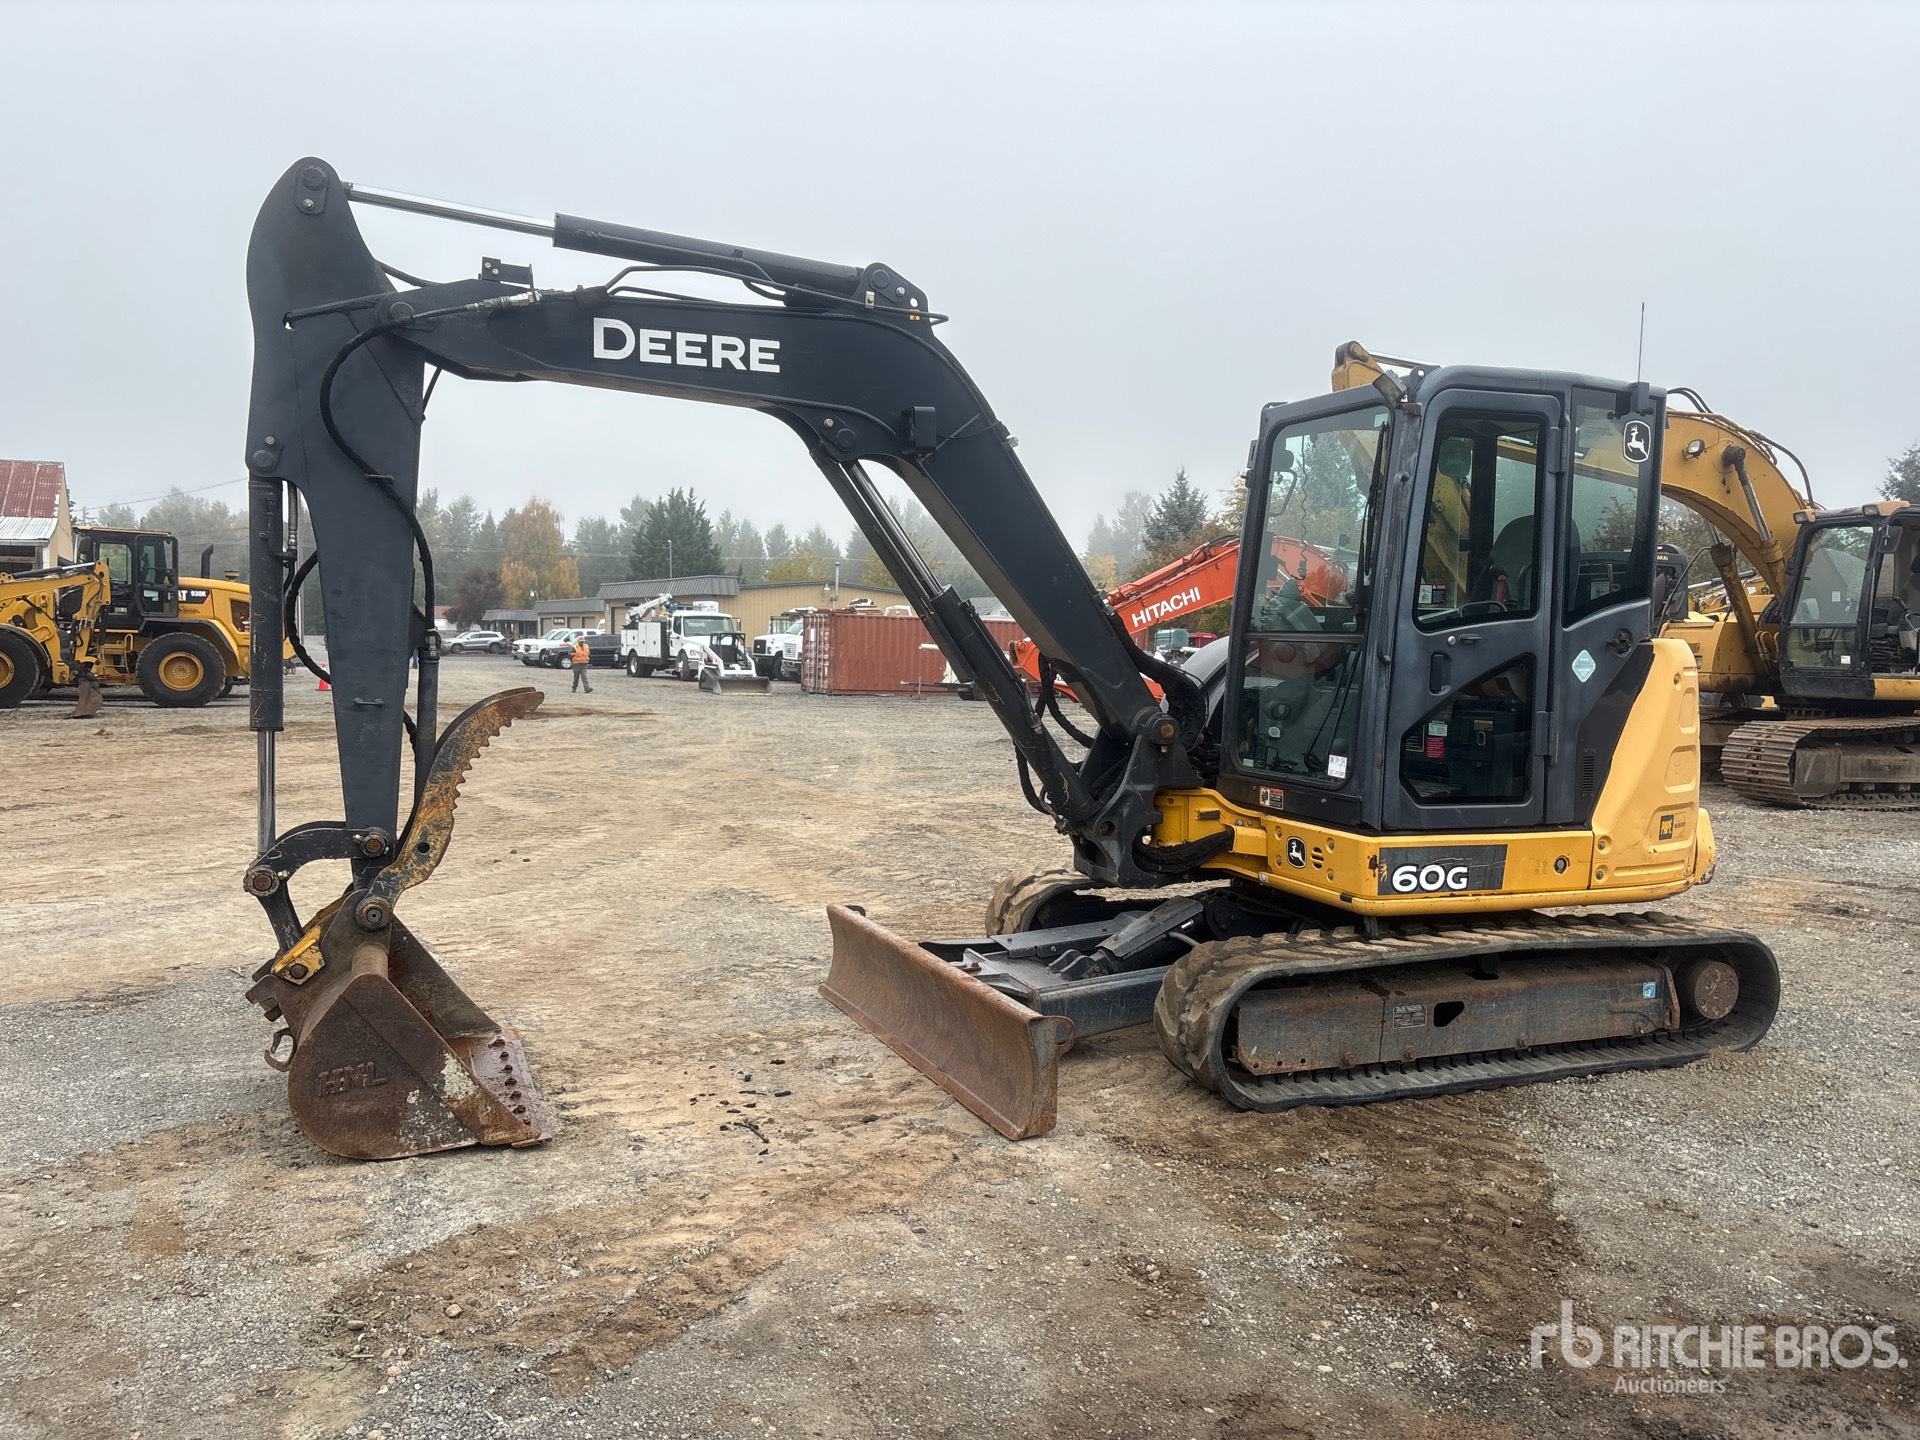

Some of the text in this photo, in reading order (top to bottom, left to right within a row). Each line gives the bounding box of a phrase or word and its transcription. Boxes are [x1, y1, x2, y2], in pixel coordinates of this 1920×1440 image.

[593, 317, 781, 374] DEERE
[178, 589, 188, 602] AT
[1131, 586, 1201, 628] HITACHI
[1391, 864, 1469, 892] 60G
